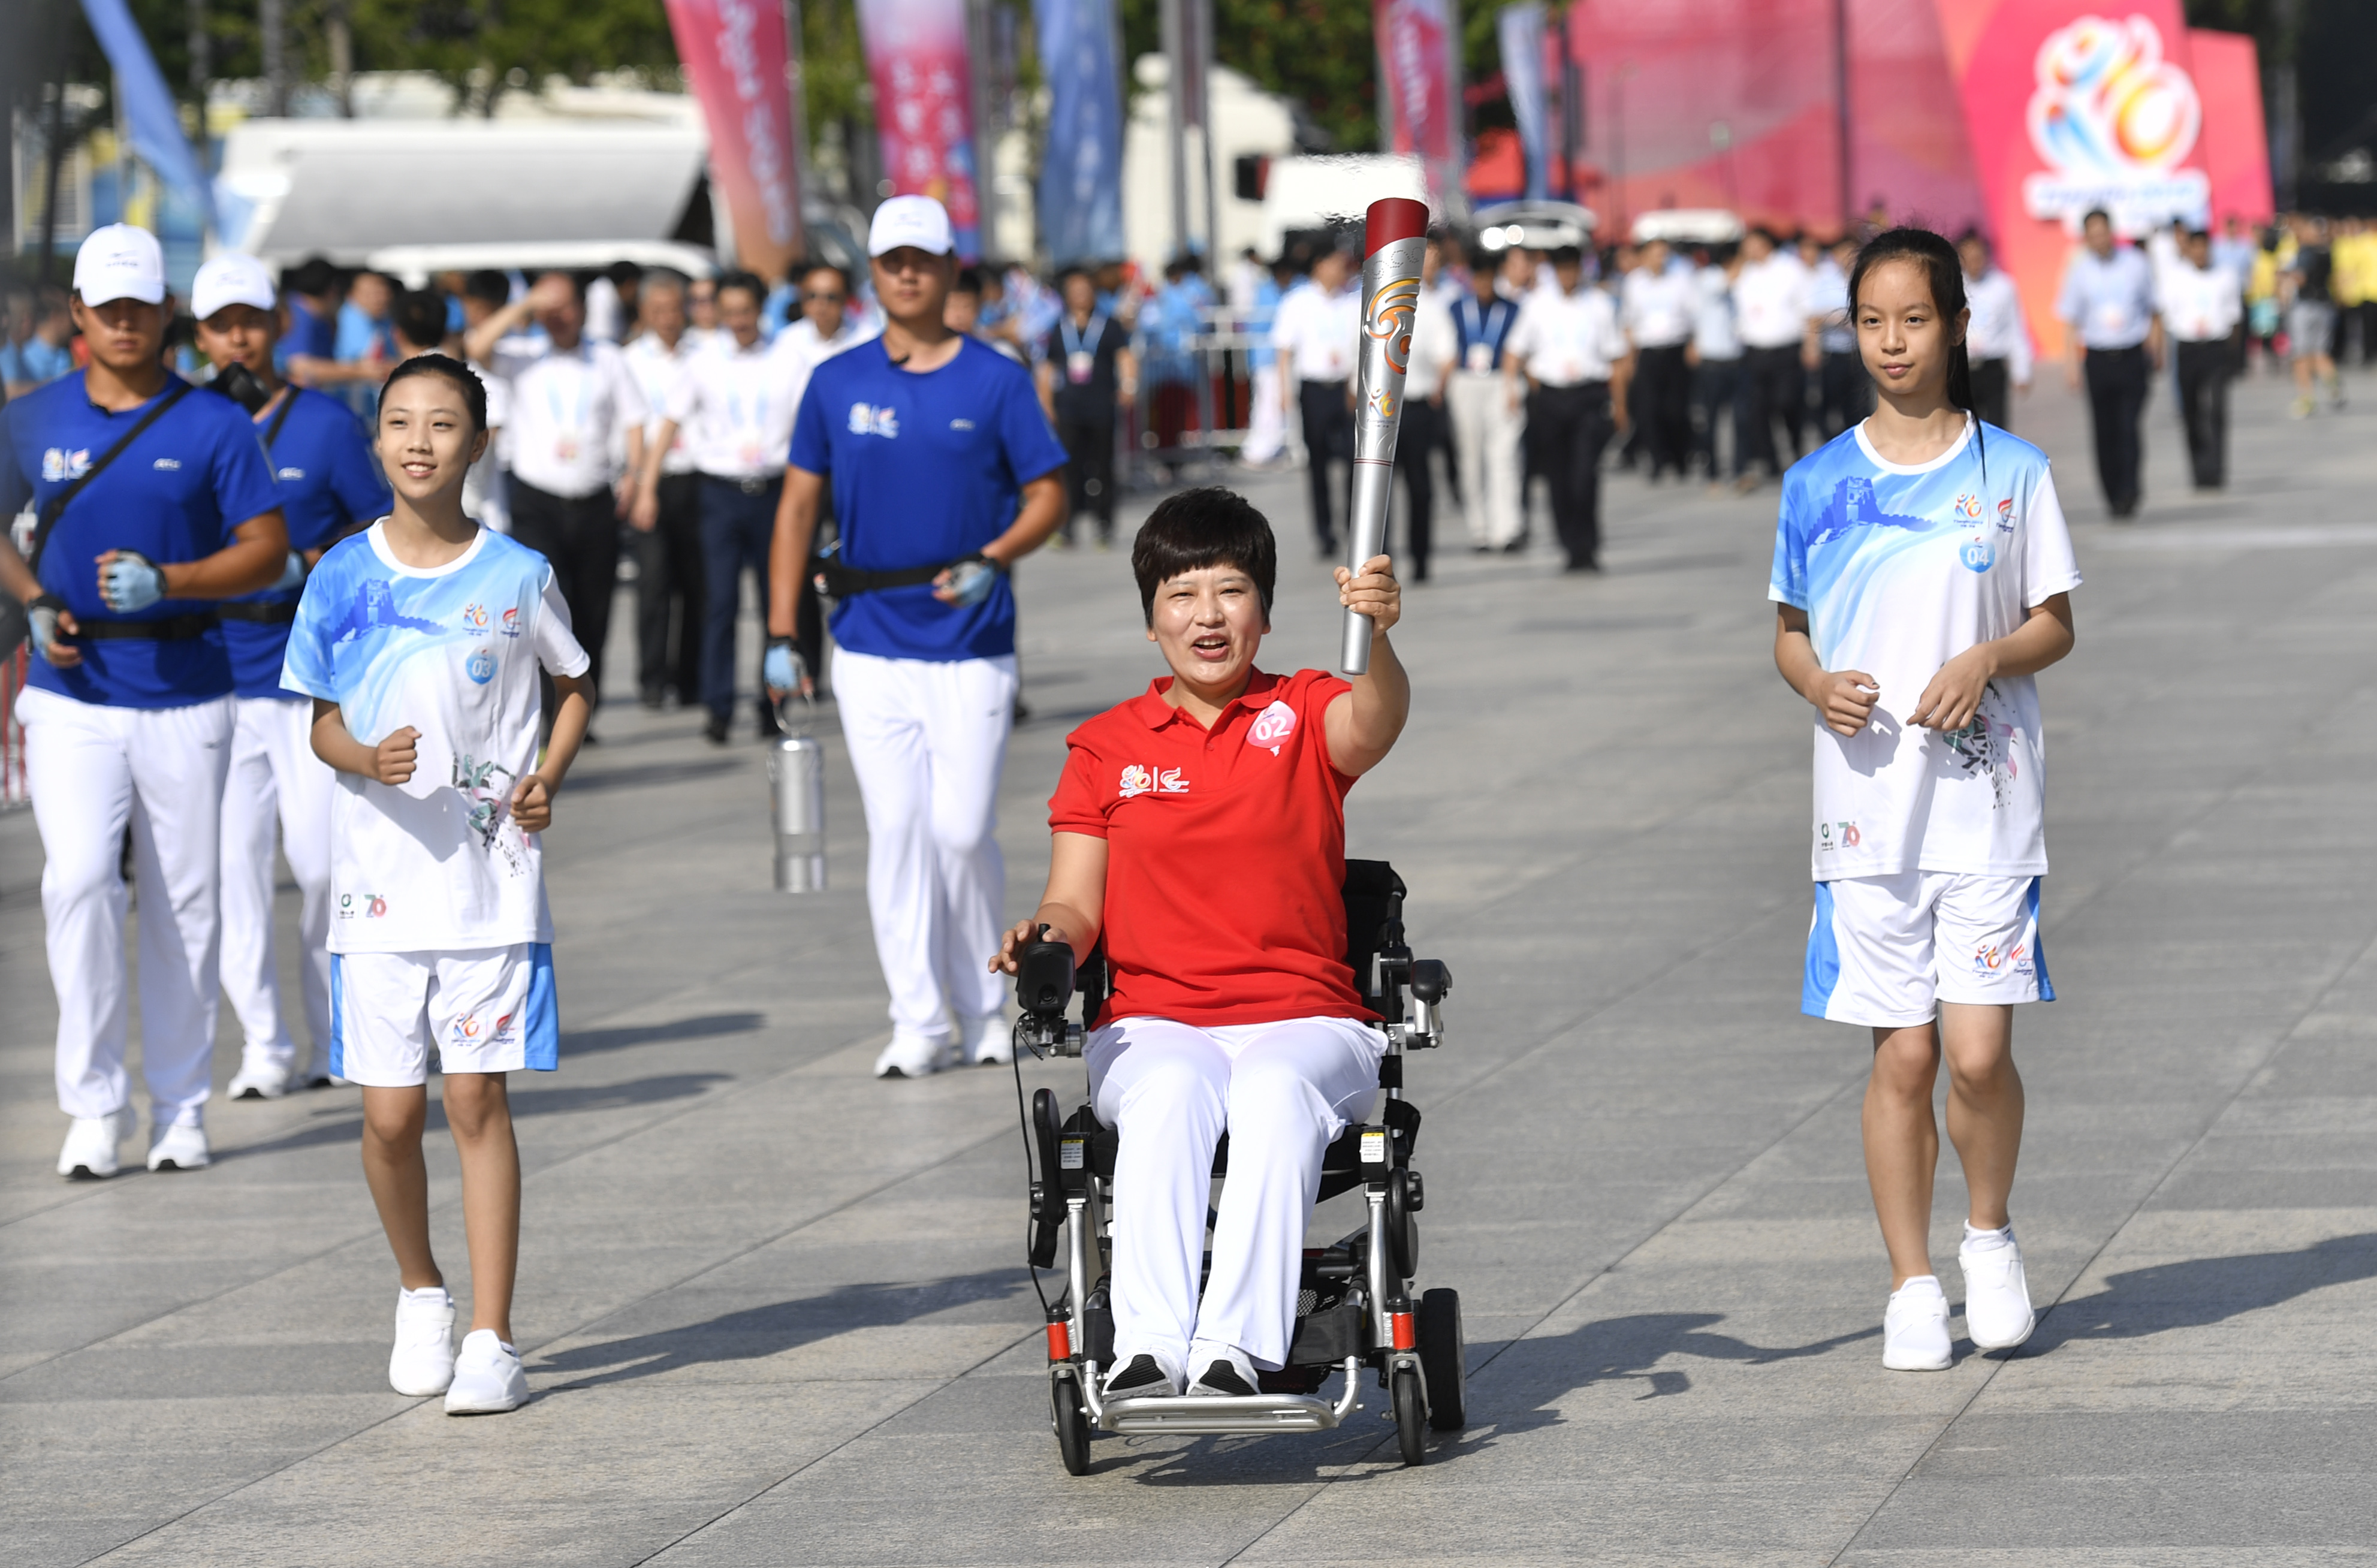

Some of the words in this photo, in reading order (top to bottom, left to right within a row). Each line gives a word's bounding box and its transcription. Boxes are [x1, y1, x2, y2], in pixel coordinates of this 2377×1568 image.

[1967, 547, 1990, 566] 04
[472, 659, 491, 678] 03
[1256, 716, 1290, 741] 02
